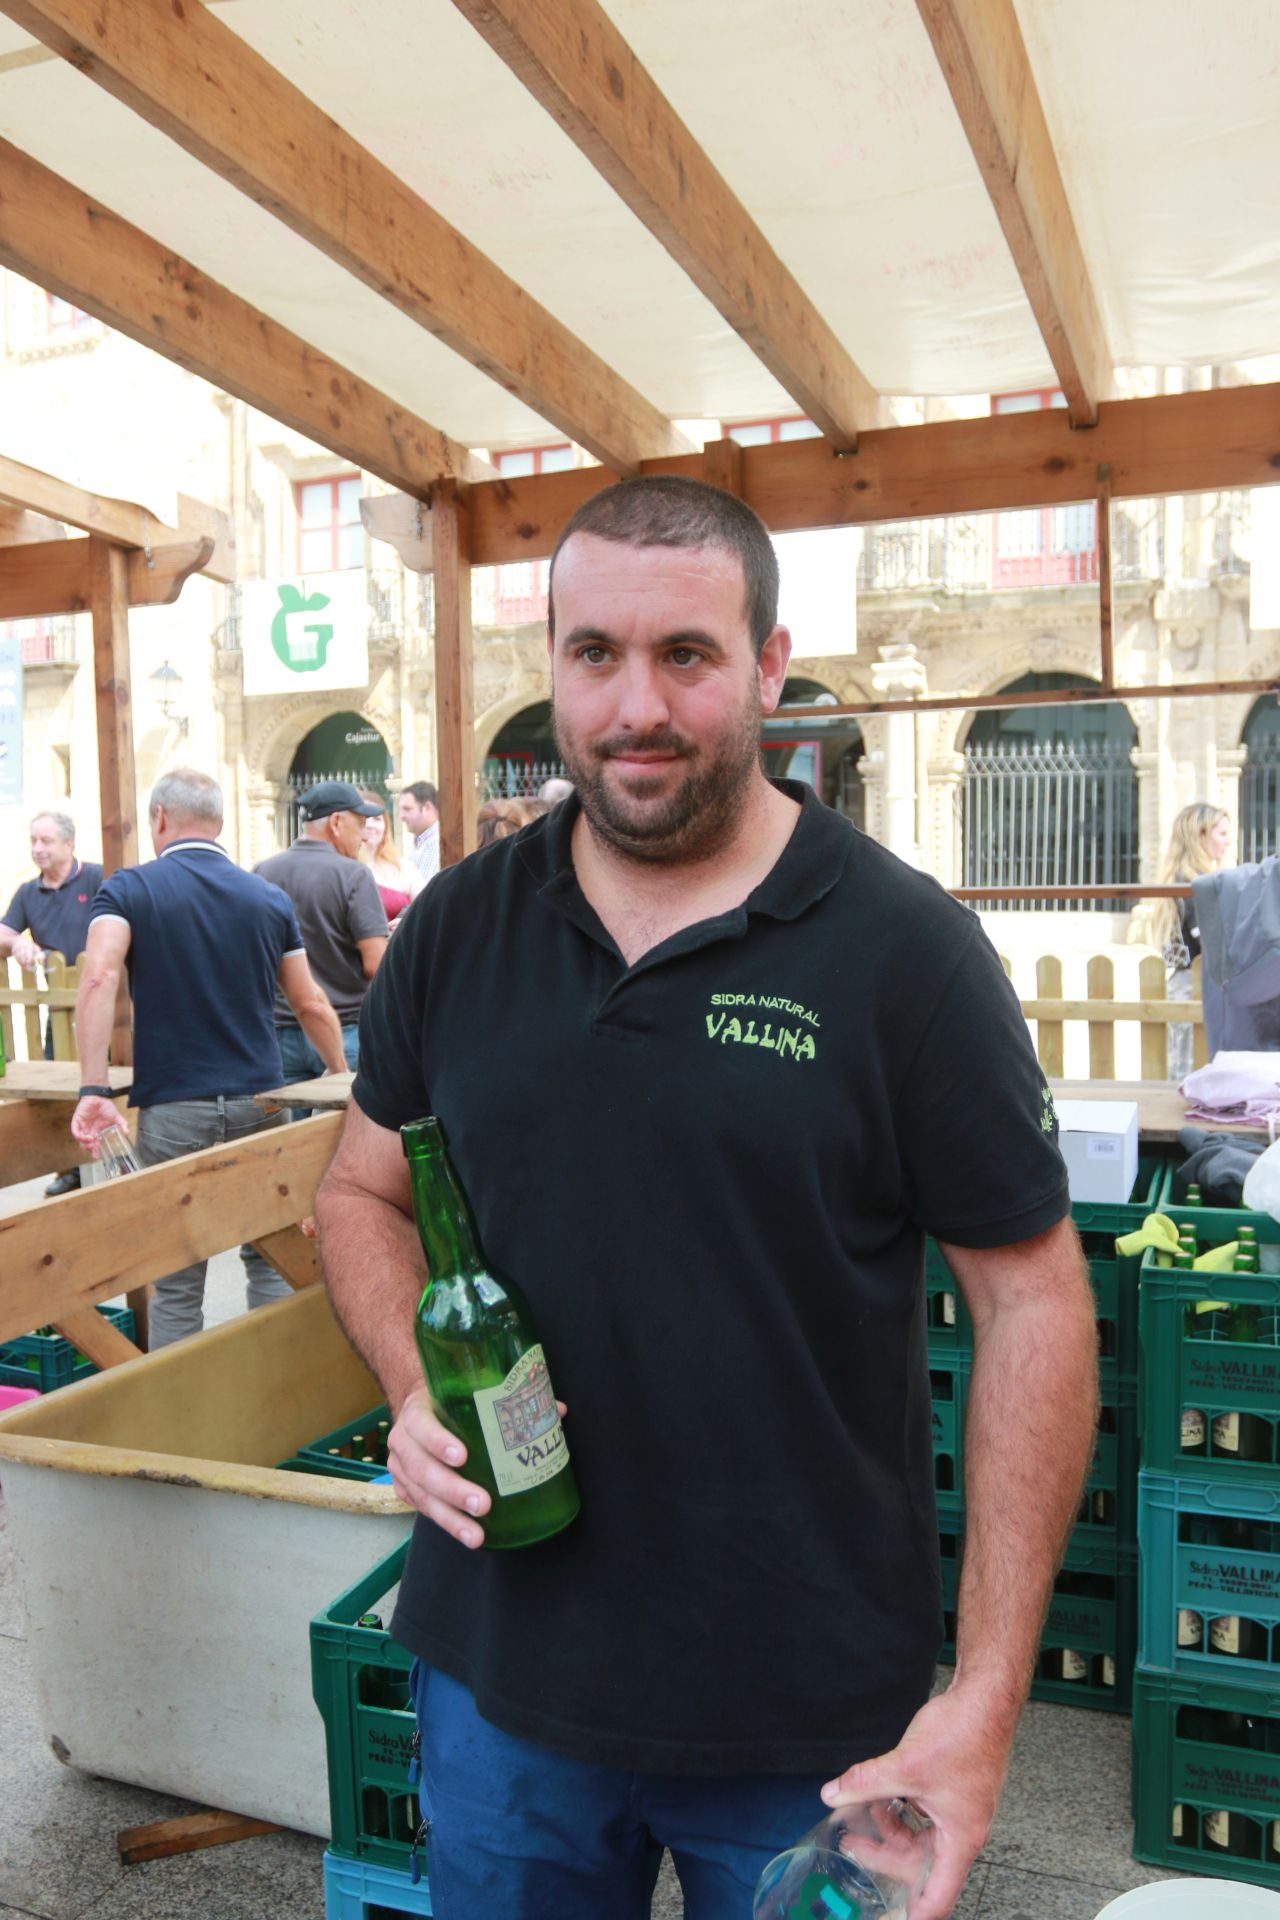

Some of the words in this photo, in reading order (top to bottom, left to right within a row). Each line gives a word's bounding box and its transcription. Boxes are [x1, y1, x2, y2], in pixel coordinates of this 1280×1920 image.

[710, 993, 756, 1006] SIDRA
[759, 995, 821, 1028] NATURAL
[705, 1012, 816, 1062] VALLINA
[503, 1359, 528, 1392] SIDRA
